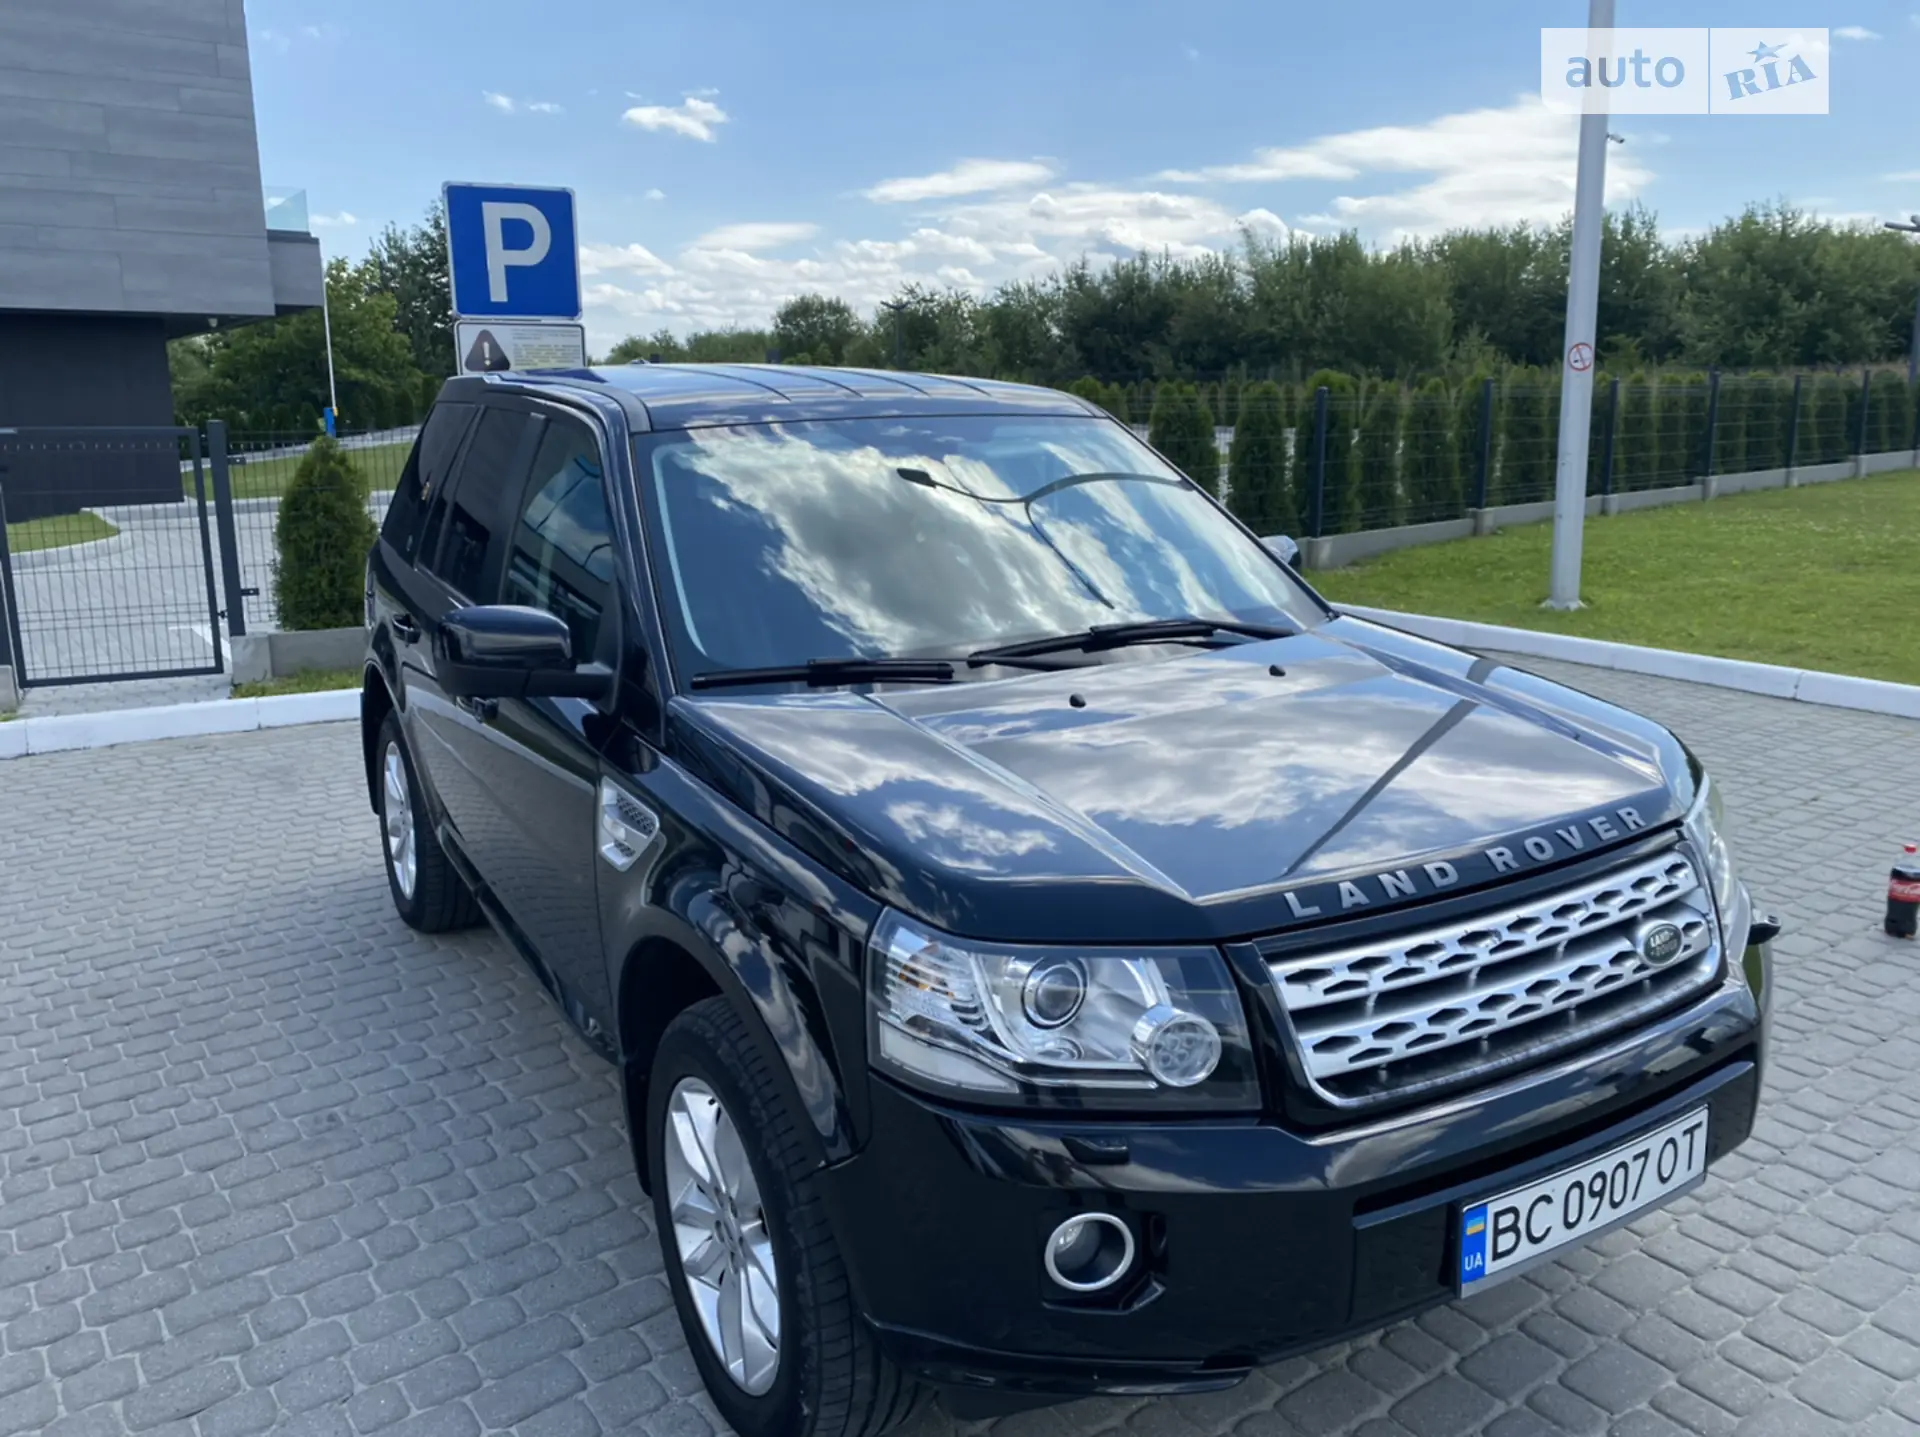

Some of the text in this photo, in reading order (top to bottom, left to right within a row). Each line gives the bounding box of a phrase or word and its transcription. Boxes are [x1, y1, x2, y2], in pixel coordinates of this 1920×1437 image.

[482, 201, 552, 303] P
[1283, 806, 1647, 919] LAND ROVER
[1464, 1252, 1484, 1272] UA
